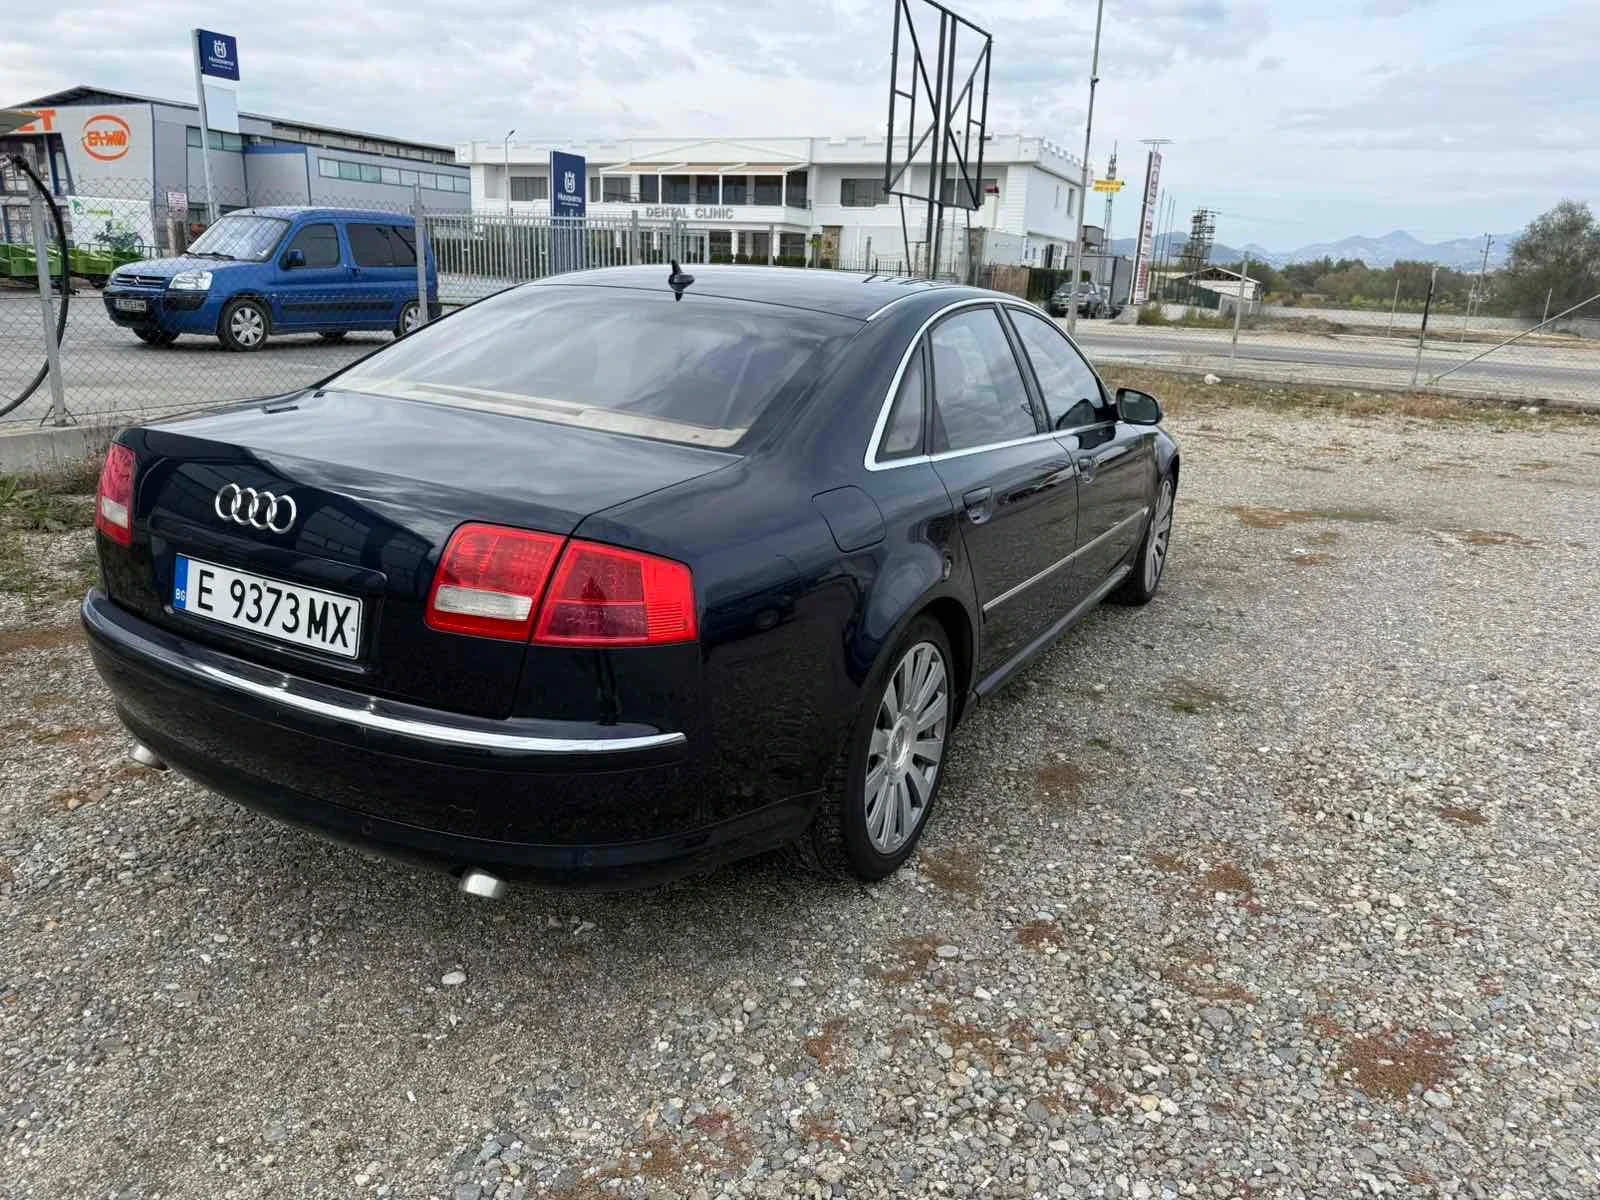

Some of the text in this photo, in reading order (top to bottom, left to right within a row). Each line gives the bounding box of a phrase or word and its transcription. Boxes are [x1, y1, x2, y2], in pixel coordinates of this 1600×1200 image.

[646, 207, 734, 220] DENTAL CLINIC
[175, 588, 187, 602] BG
[198, 569, 352, 648] E 9373 MX
